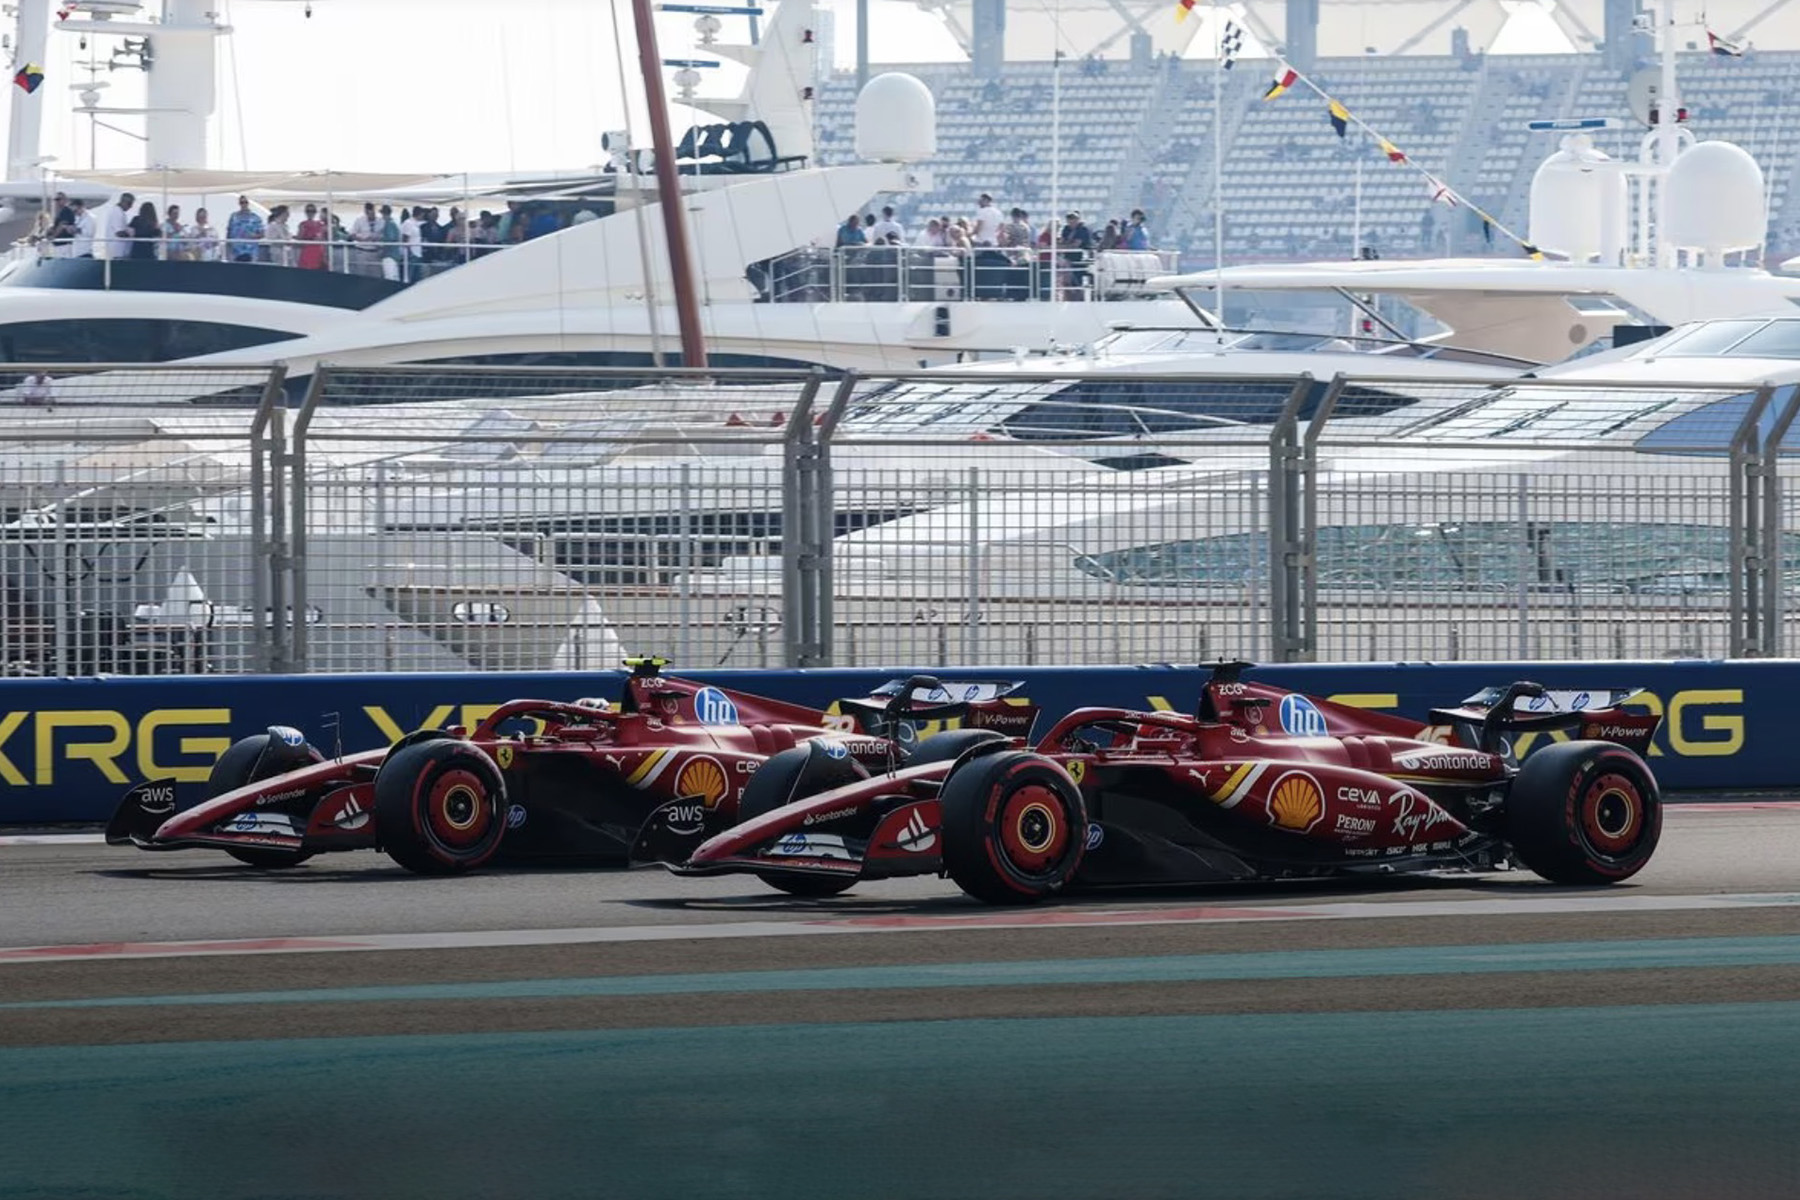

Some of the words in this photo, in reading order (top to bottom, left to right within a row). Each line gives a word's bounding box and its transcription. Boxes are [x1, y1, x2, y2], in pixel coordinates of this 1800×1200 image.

[702, 688, 731, 725] hp
[1289, 694, 1319, 736] hp
[1600, 725, 1649, 737] V-Power
[1421, 756, 1492, 770] Santander
[141, 786, 174, 803] aws
[667, 805, 703, 822] aws
[815, 806, 858, 824] Santander
[1336, 813, 1377, 832] PERONI
